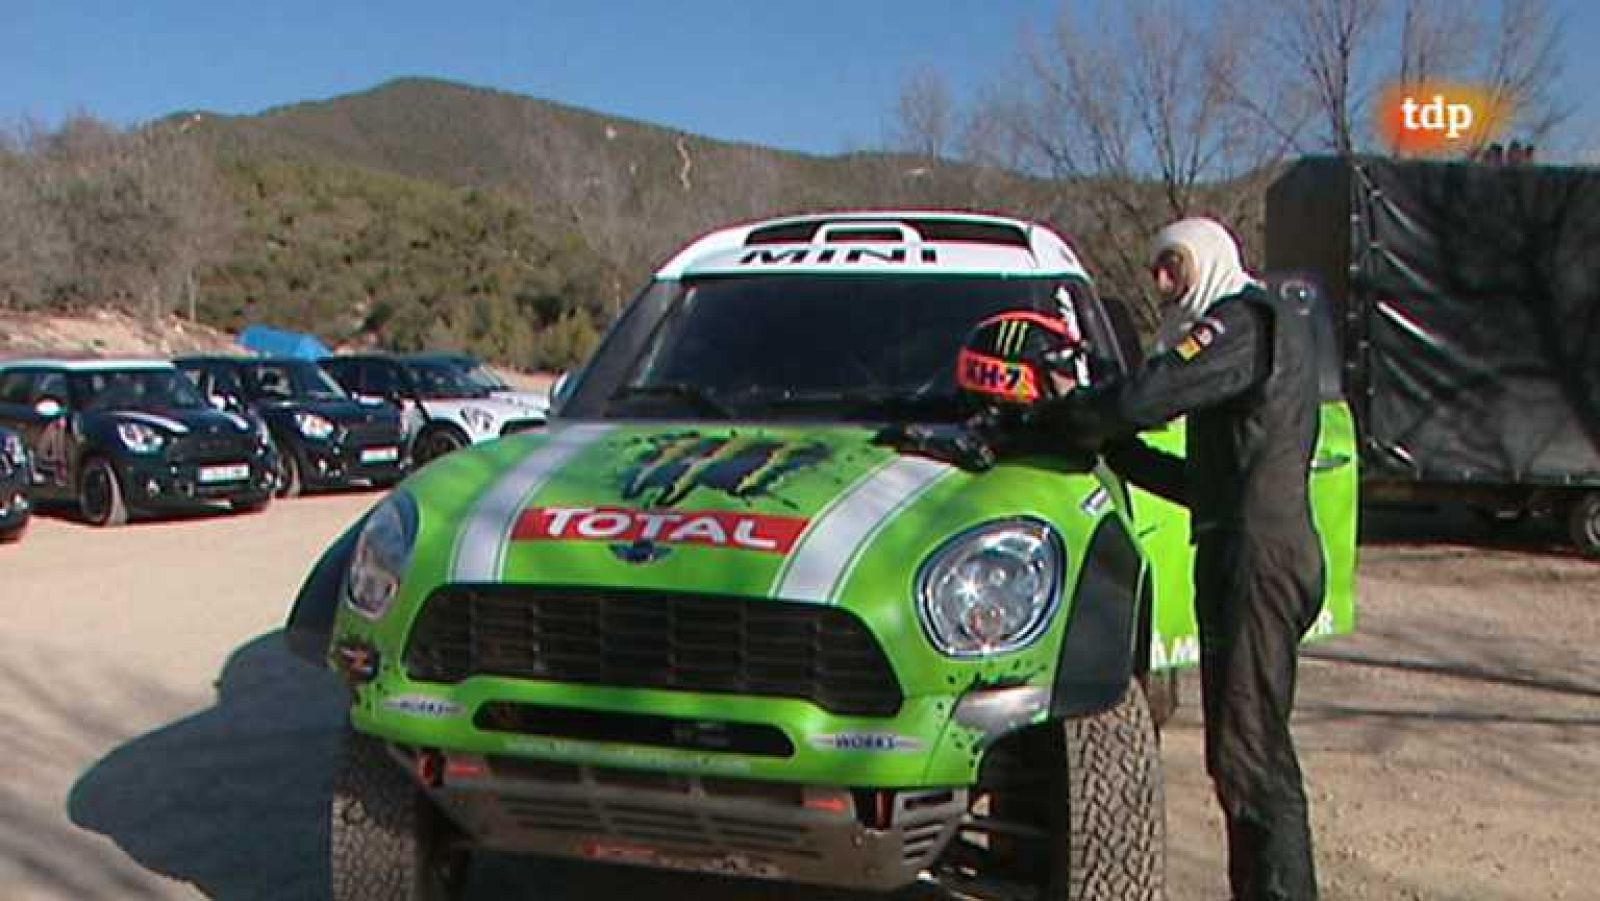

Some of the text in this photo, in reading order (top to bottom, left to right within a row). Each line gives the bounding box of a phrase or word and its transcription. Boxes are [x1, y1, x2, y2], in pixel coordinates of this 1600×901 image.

[740, 249, 938, 264] MINI
[967, 358, 1021, 391] KH-7
[543, 508, 778, 549] TOTAL
